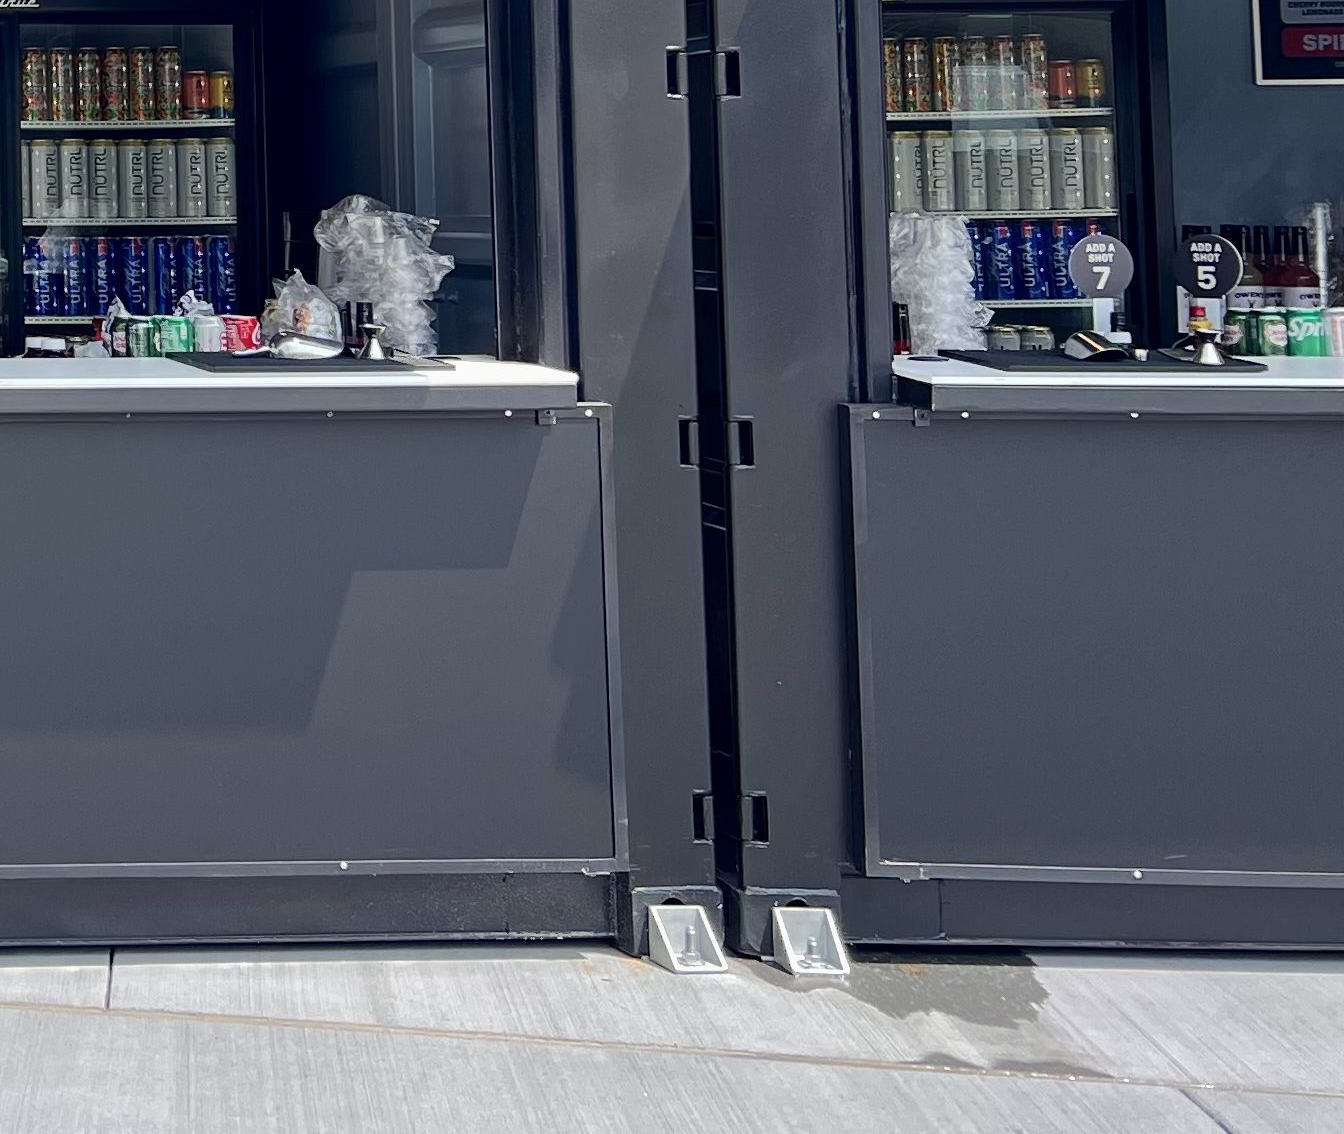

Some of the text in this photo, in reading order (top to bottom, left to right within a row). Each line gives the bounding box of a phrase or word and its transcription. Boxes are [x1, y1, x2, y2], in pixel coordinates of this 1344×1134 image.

[1085, 243, 1116, 253] ADD A
[1190, 242, 1222, 252] ADD A
[1088, 253, 1114, 263] SHOT
[1192, 253, 1221, 263] SHOT
[1092, 266, 1111, 290] 7
[1197, 266, 1217, 290] 5
